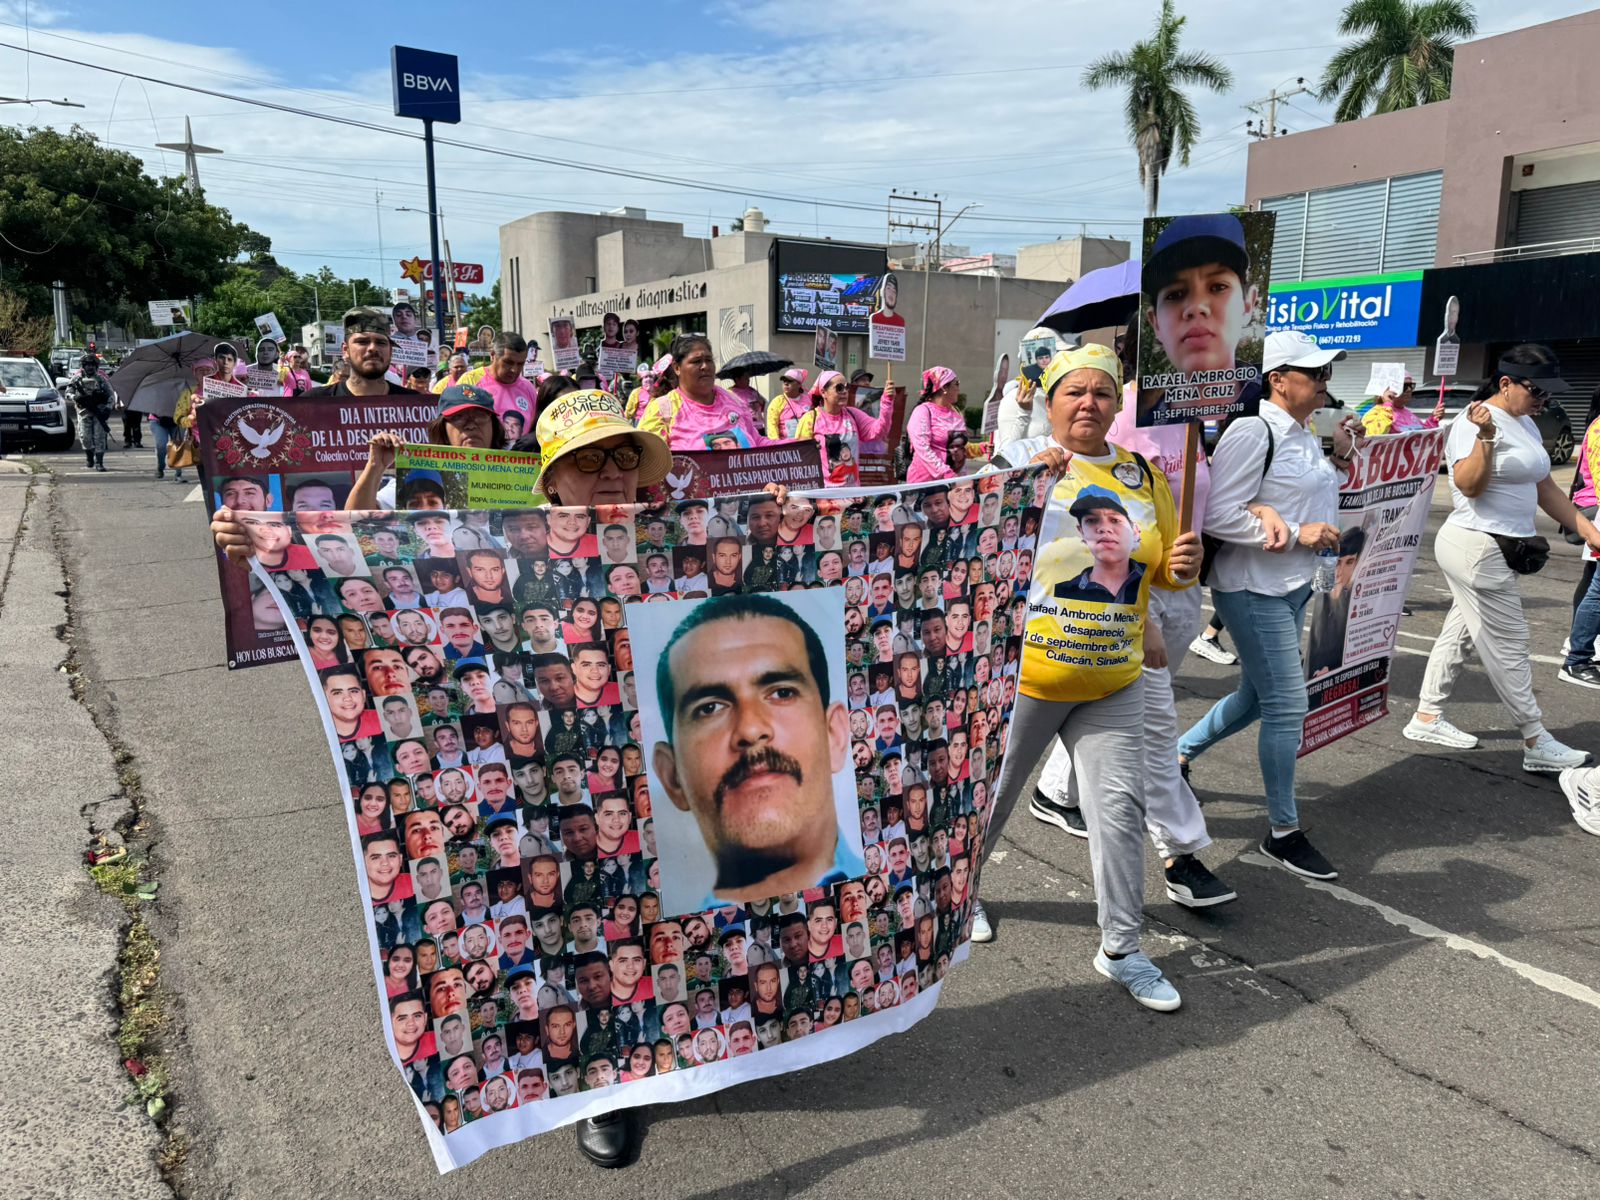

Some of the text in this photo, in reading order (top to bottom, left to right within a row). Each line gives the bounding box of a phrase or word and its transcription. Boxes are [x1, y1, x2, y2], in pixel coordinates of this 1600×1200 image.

[403, 72, 452, 93] BBVA
[1266, 285, 1392, 325] isioVital
[1318, 335, 1333, 345] (667)
[1143, 366, 1257, 389] RAFAEL AMBROCIO
[1165, 384, 1236, 403] MENA CRUZ
[340, 407, 361, 425] DIA
[311, 430, 327, 447] DE
[329, 429, 344, 446] LA
[315, 450, 348, 463] Colectivo
[471, 453, 480, 462] a
[743, 449, 802, 468] INTERNACIONAL
[409, 459, 535, 475] RAFAEL AMBROSIO MENA CRUZ
[471, 481, 513, 491] MUNICIPIO:
[710, 465, 820, 489] DE LA DESAPARICION FORZADA
[1060, 607, 1111, 622] Ambrocio
[1063, 623, 1125, 639] desapareció
[1030, 632, 1044, 643] de
[1046, 637, 1108, 652] septiembre
[1110, 641, 1120, 651] de
[236, 649, 251, 664] HOY
[251, 647, 267, 661] LOS
[1046, 649, 1129, 668] Culiacán, Sinaloa
